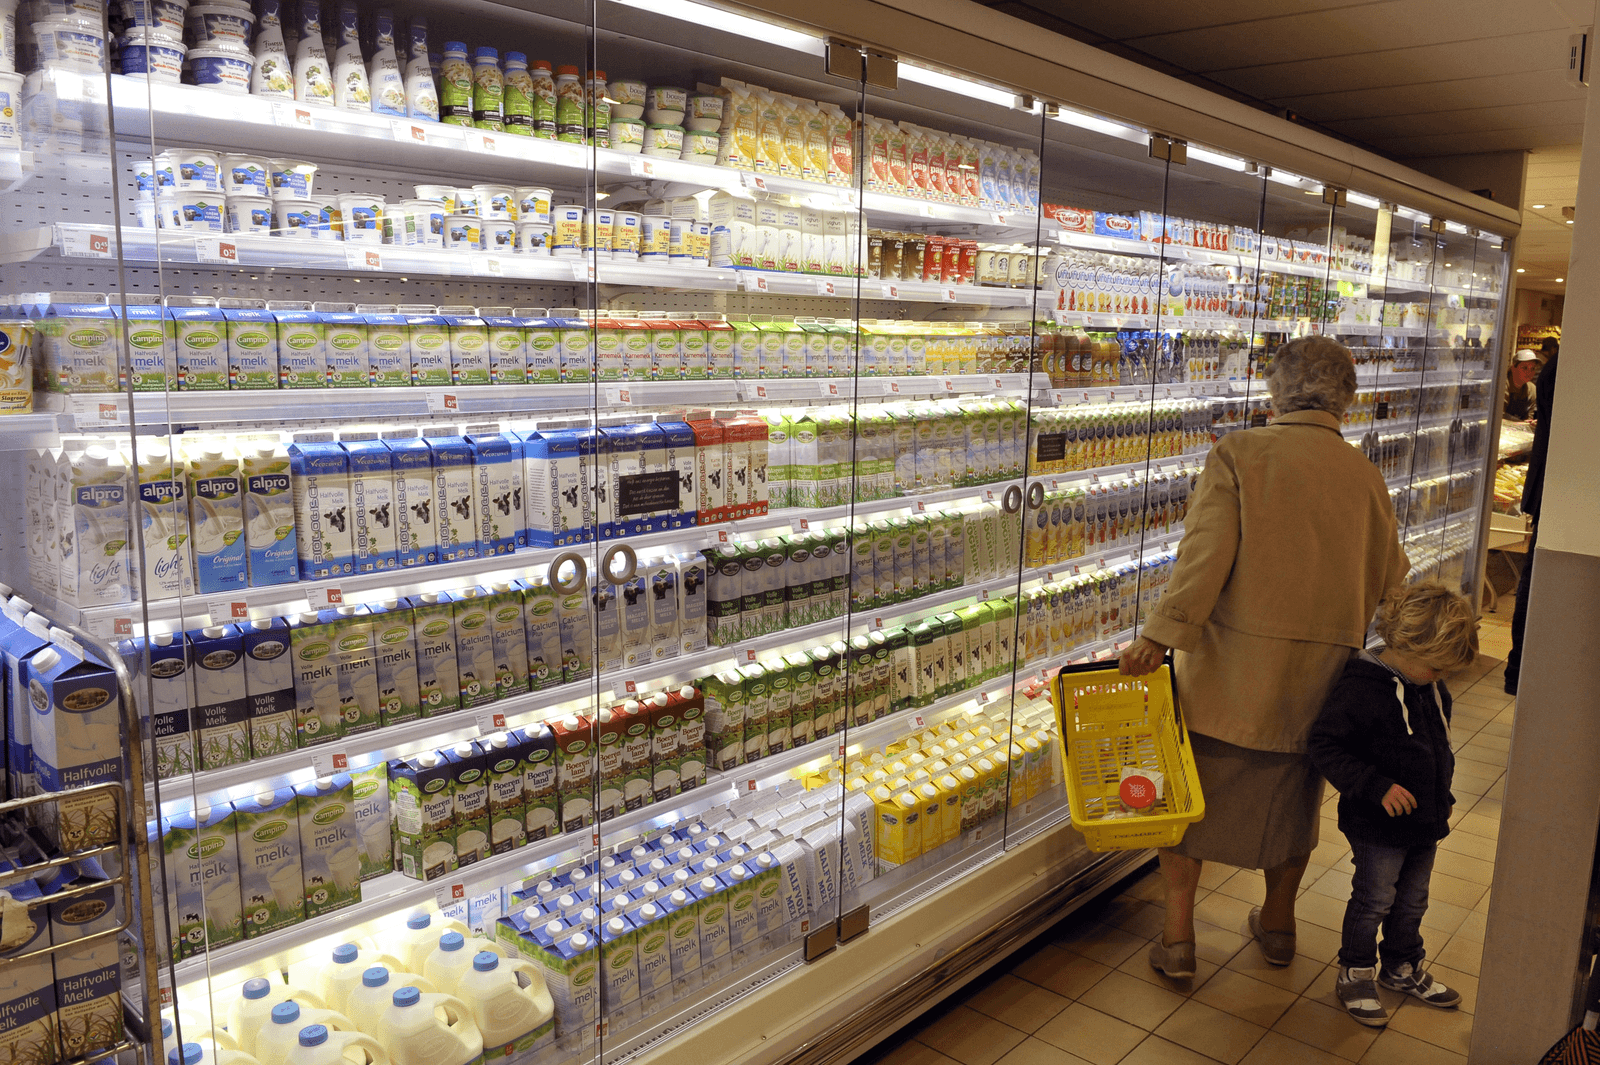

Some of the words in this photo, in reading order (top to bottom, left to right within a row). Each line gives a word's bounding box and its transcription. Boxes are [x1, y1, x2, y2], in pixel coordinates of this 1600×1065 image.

[737, 128, 756, 139] pap
[763, 133, 780, 144] pap
[786, 138, 803, 149] pap
[809, 142, 827, 152] pap
[834, 146, 851, 156] pap
[873, 155, 887, 164] pap
[1062, 213, 1079, 223] Yakult
[1111, 219, 1127, 227] Yakult
[69, 334, 106, 343] Campina
[186, 336, 218, 344] Campina
[238, 336, 268, 344] Campina
[74, 358, 104, 366] melk
[135, 357, 164, 366] melk
[190, 358, 217, 366] melk
[241, 356, 267, 366] melk
[292, 357, 316, 366] melk
[336, 357, 359, 365] melk
[379, 357, 402, 365] melk
[421, 356, 442, 364] melk
[462, 356, 482, 364] melk
[536, 356, 553, 364] melk
[569, 356, 586, 364] melk
[200, 481, 235, 494] alpro
[252, 478, 286, 490] alpro
[81, 489, 121, 501] alpro
[144, 485, 180, 498] alpro
[550, 460, 561, 535] BIOLOGISCH
[437, 468, 450, 549] BIOLOGISCH
[480, 466, 491, 544] BIOLOGISCH
[354, 474, 368, 559] BIOLOGISCH
[396, 471, 410, 554] BIOLOGISCH
[308, 476, 324, 564] BIOLOGISCH
[265, 548, 295, 558] Original
[966, 518, 980, 577] YOGHURT
[213, 553, 244, 564] Original
[89, 560, 121, 584] light
[562, 614, 586, 625] Calcium
[423, 622, 449, 632] Campina
[531, 621, 557, 632] Calcium
[381, 629, 409, 639] Campina
[495, 628, 523, 639] Calcium
[340, 636, 368, 647] Campina
[461, 634, 490, 646] Calcium
[300, 645, 330, 656] Campina
[425, 643, 451, 656] melk
[383, 650, 411, 664] melk
[341, 656, 370, 671] melk
[302, 666, 332, 681] melk
[254, 696, 275, 705] Volle
[205, 706, 226, 716] Volle
[256, 705, 276, 715] Melk
[205, 715, 227, 726] Melk
[682, 726, 703, 735] Boeren
[656, 734, 678, 744] Boeren
[627, 742, 650, 752] Boeren
[566, 761, 590, 771] Boeren
[603, 759, 617, 767] land
[63, 763, 117, 783] Halfvolle
[527, 768, 554, 780] Boeren
[571, 767, 586, 775] land
[493, 779, 520, 791] Boeren
[533, 776, 549, 785] land
[354, 783, 378, 795] ampina
[500, 787, 516, 796] land
[458, 790, 485, 802] Boeren
[424, 800, 450, 812] Boeren
[464, 798, 480, 807] land
[314, 808, 345, 820] Campina
[430, 807, 446, 818] land
[255, 824, 288, 837] Campina
[314, 826, 337, 835] Halfvolle
[315, 828, 347, 847] melk
[860, 810, 874, 869] HALFVOLLE
[189, 840, 224, 854] Campina
[255, 843, 280, 853] Halfvolle
[255, 846, 290, 865] melk
[859, 841, 867, 869] MELK
[189, 862, 227, 882] melk
[475, 892, 497, 907] melk
[761, 899, 779, 914] melk
[735, 912, 754, 928] melk
[706, 926, 726, 942] melk
[676, 940, 696, 956] melk
[645, 955, 667, 971] melk
[63, 970, 116, 992] Halfvolle
[613, 969, 635, 987] melk
[64, 988, 94, 1004] Melk
[574, 986, 597, 1006] melk
